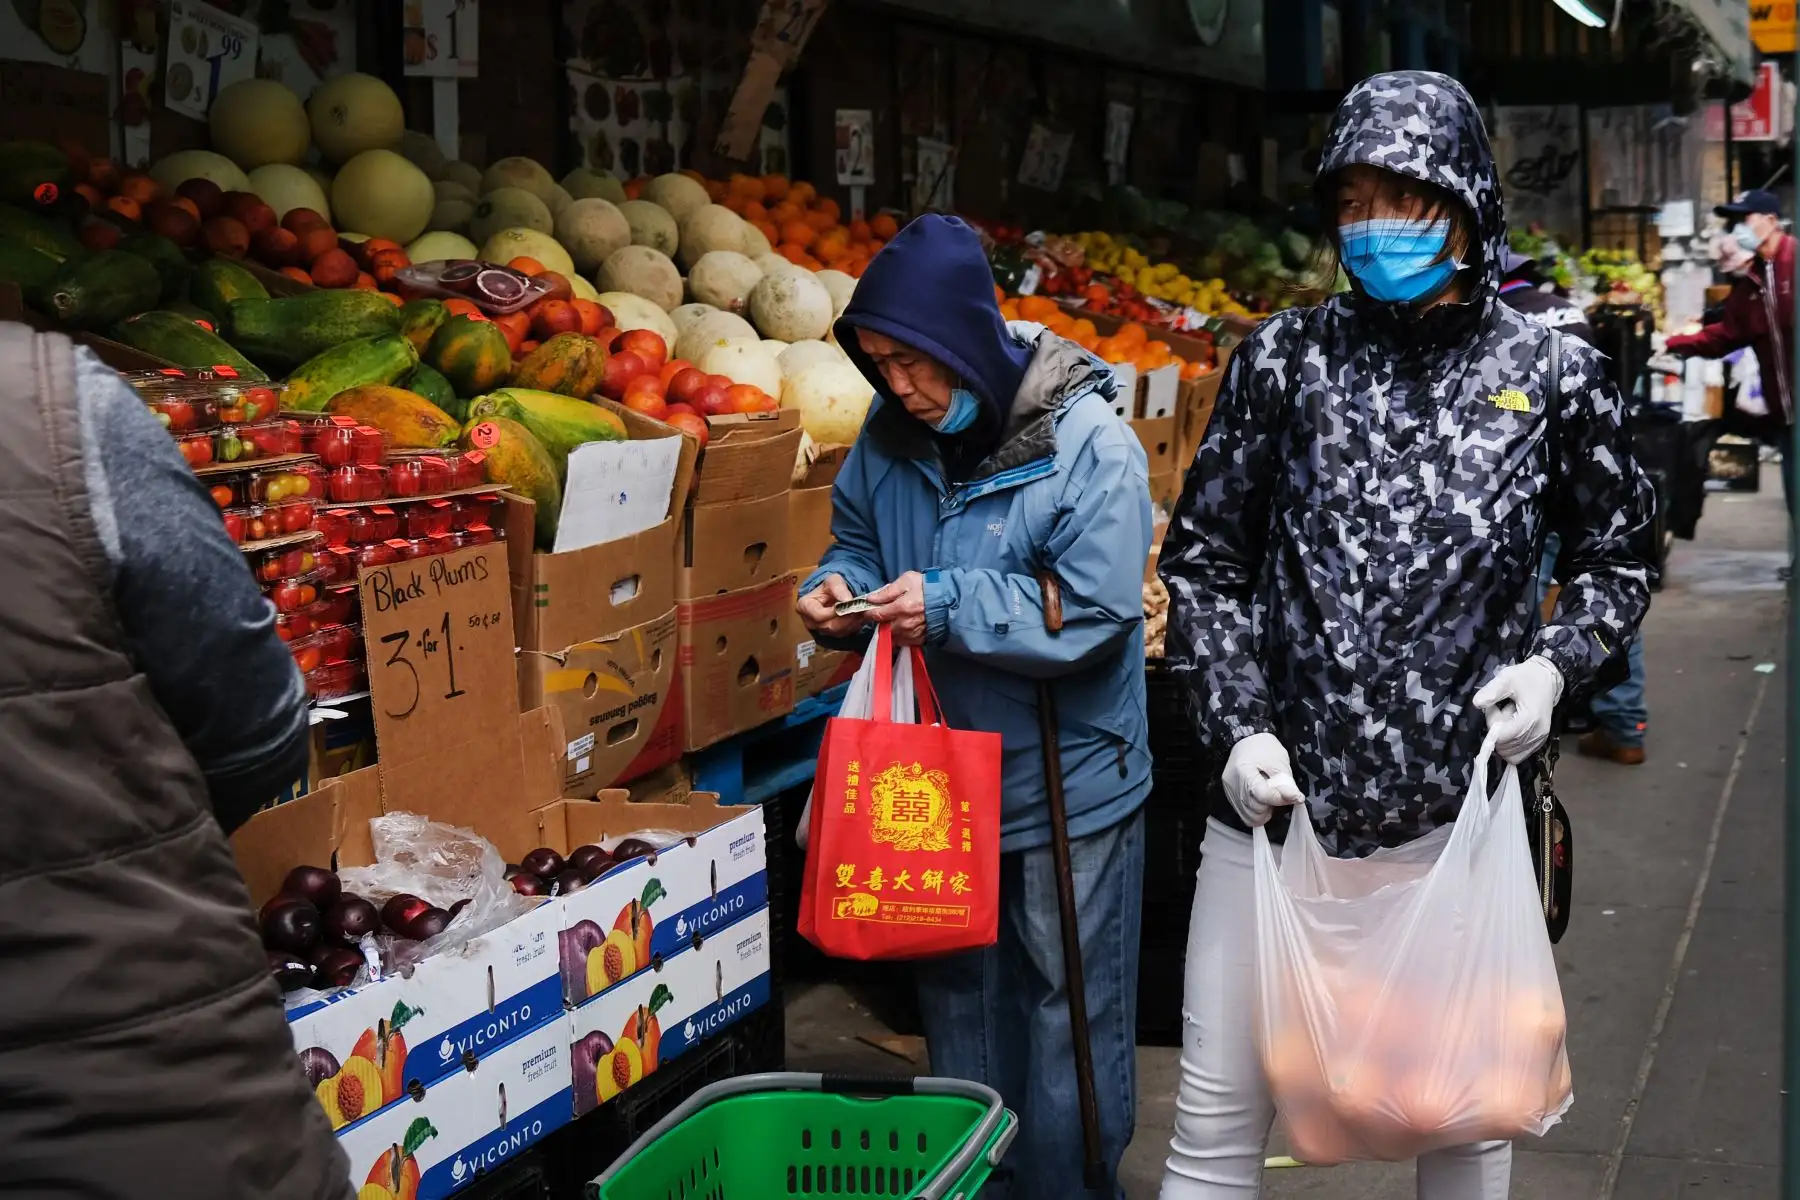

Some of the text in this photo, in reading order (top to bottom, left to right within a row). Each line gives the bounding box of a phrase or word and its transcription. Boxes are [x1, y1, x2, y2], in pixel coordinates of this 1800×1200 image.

[1487, 394, 1518, 405] NORTH
[1495, 402, 1518, 410] FACE
[1501, 389, 1518, 398] THE
[365, 556, 488, 612] Black Plums
[381, 630, 419, 720] 3
[589, 692, 657, 727] Bagged Bananas
[729, 831, 755, 854] premium
[733, 843, 756, 861] fresh fruit
[835, 863, 973, 895] 雙喜大餅家
[689, 895, 744, 933] VICONTO
[736, 931, 762, 954] premium
[457, 1005, 531, 1054] VICONTO
[697, 994, 751, 1036] VICONTO
[522, 1045, 557, 1075] premium
[527, 1059, 557, 1083] fresh fruit
[469, 1120, 542, 1173] VICONTO
